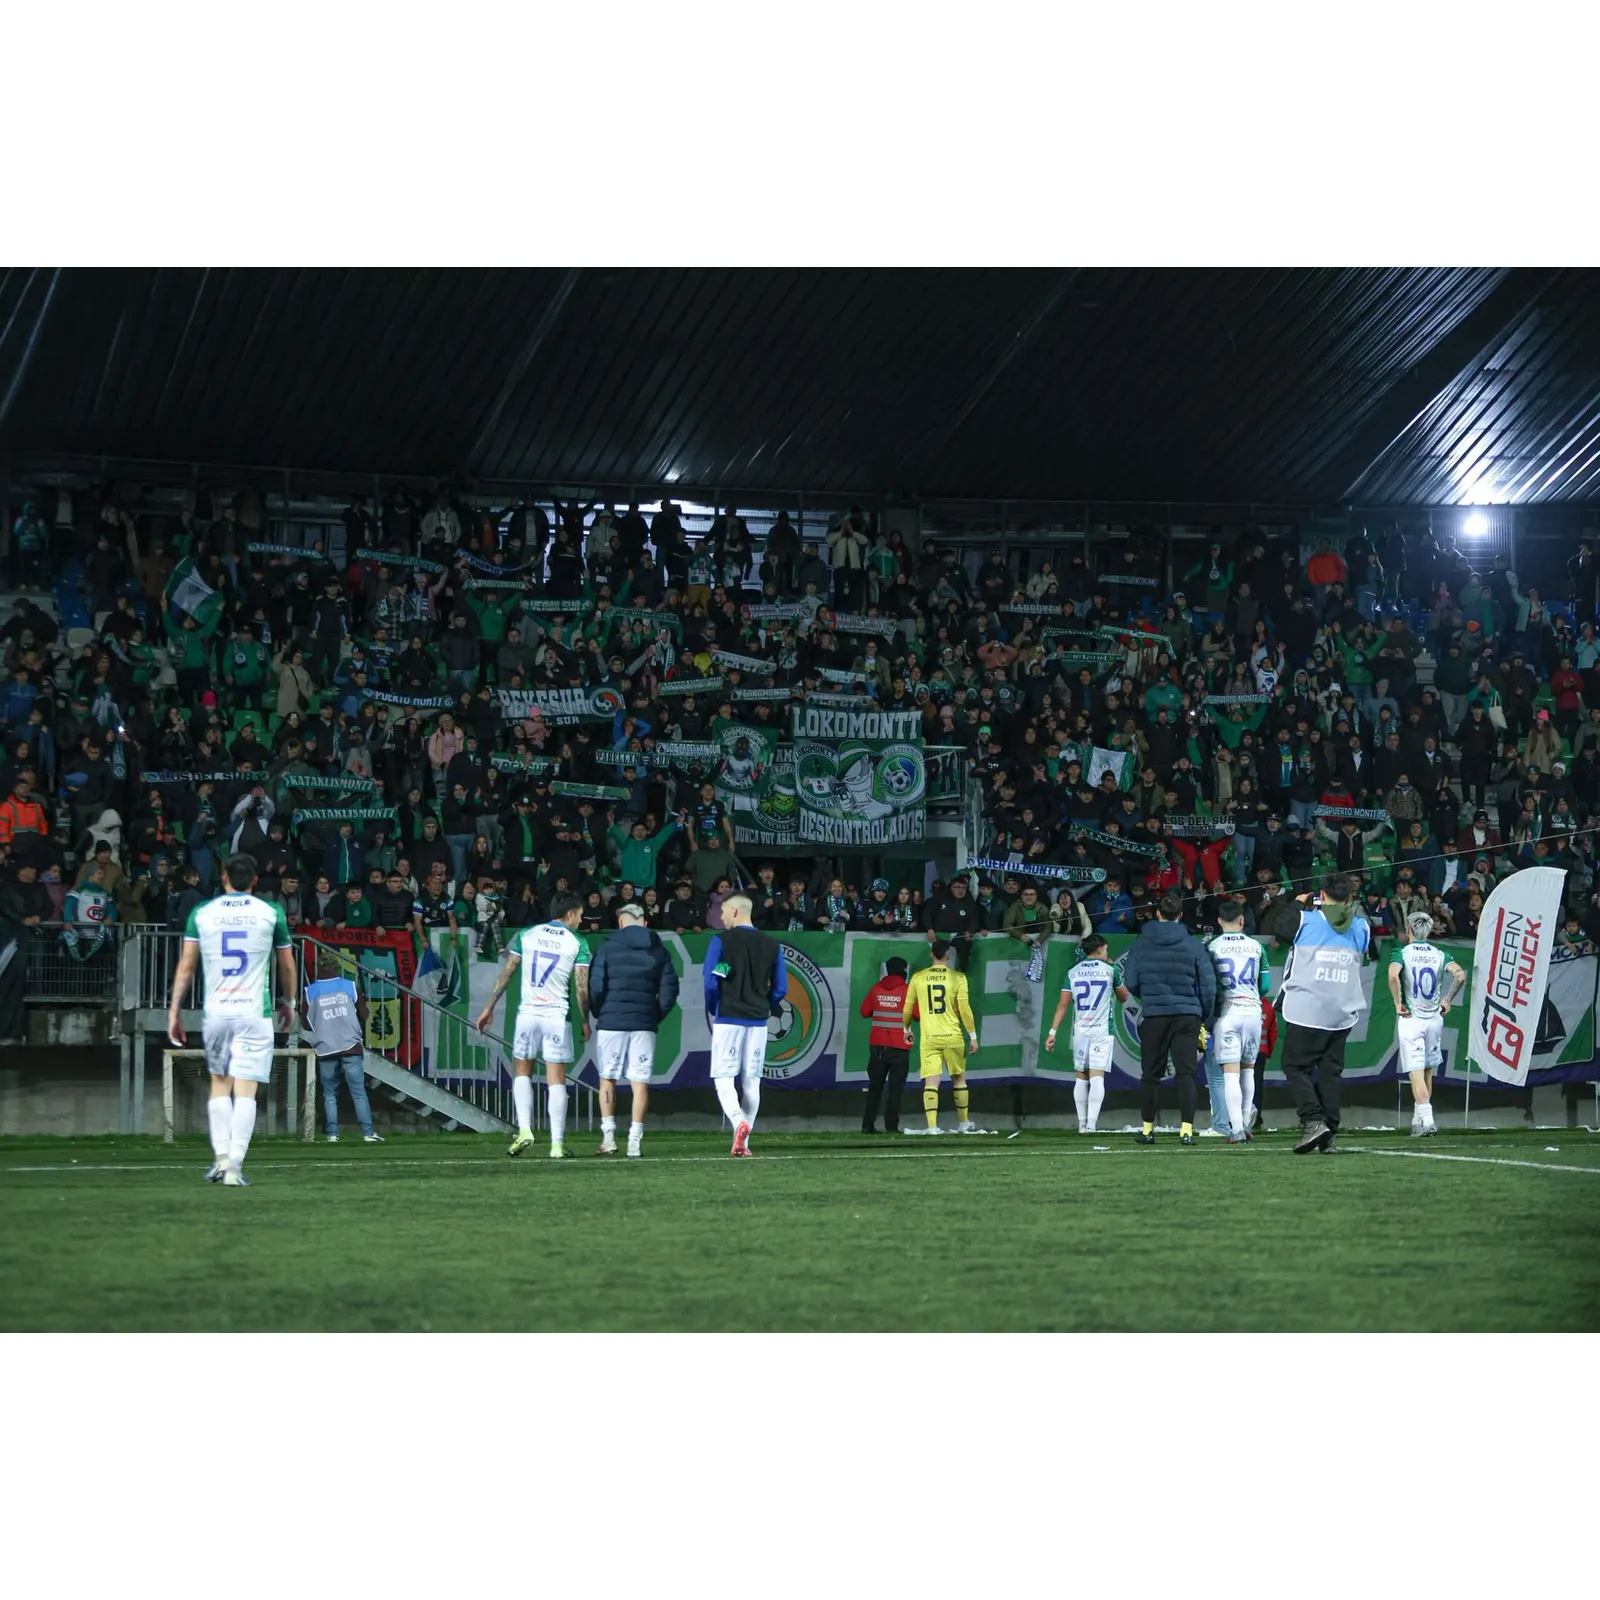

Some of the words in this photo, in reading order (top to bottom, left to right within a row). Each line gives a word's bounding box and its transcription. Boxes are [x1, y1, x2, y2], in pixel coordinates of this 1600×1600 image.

[556, 716, 579, 725] SUR
[793, 706, 923, 740] LOKOMONTT
[303, 807, 394, 818] KATAKLISMONTT
[1164, 815, 1184, 825] LOS
[1188, 815, 1208, 826] DEL
[1212, 815, 1235, 825] SUR
[800, 808, 925, 845] DESKONTROLADOS
[977, 857, 1021, 872] PUERTO
[321, 930, 386, 943] DEPORTES
[538, 938, 561, 950] NIETO
[222, 931, 249, 977] 5
[1496, 911, 1524, 1000] OCEAN
[1512, 917, 1542, 1009] TRUCK
[531, 950, 560, 988] 17
[797, 956, 823, 984] MONTT
[1315, 967, 1349, 983] CLUB
[1412, 966, 1437, 1000] 10
[877, 995, 901, 1003] SEGURIDAD
[927, 984, 947, 1015] 13
[1074, 980, 1107, 1011] 27
[323, 1006, 349, 1020] CLUB
[761, 1068, 790, 1078] HILE
